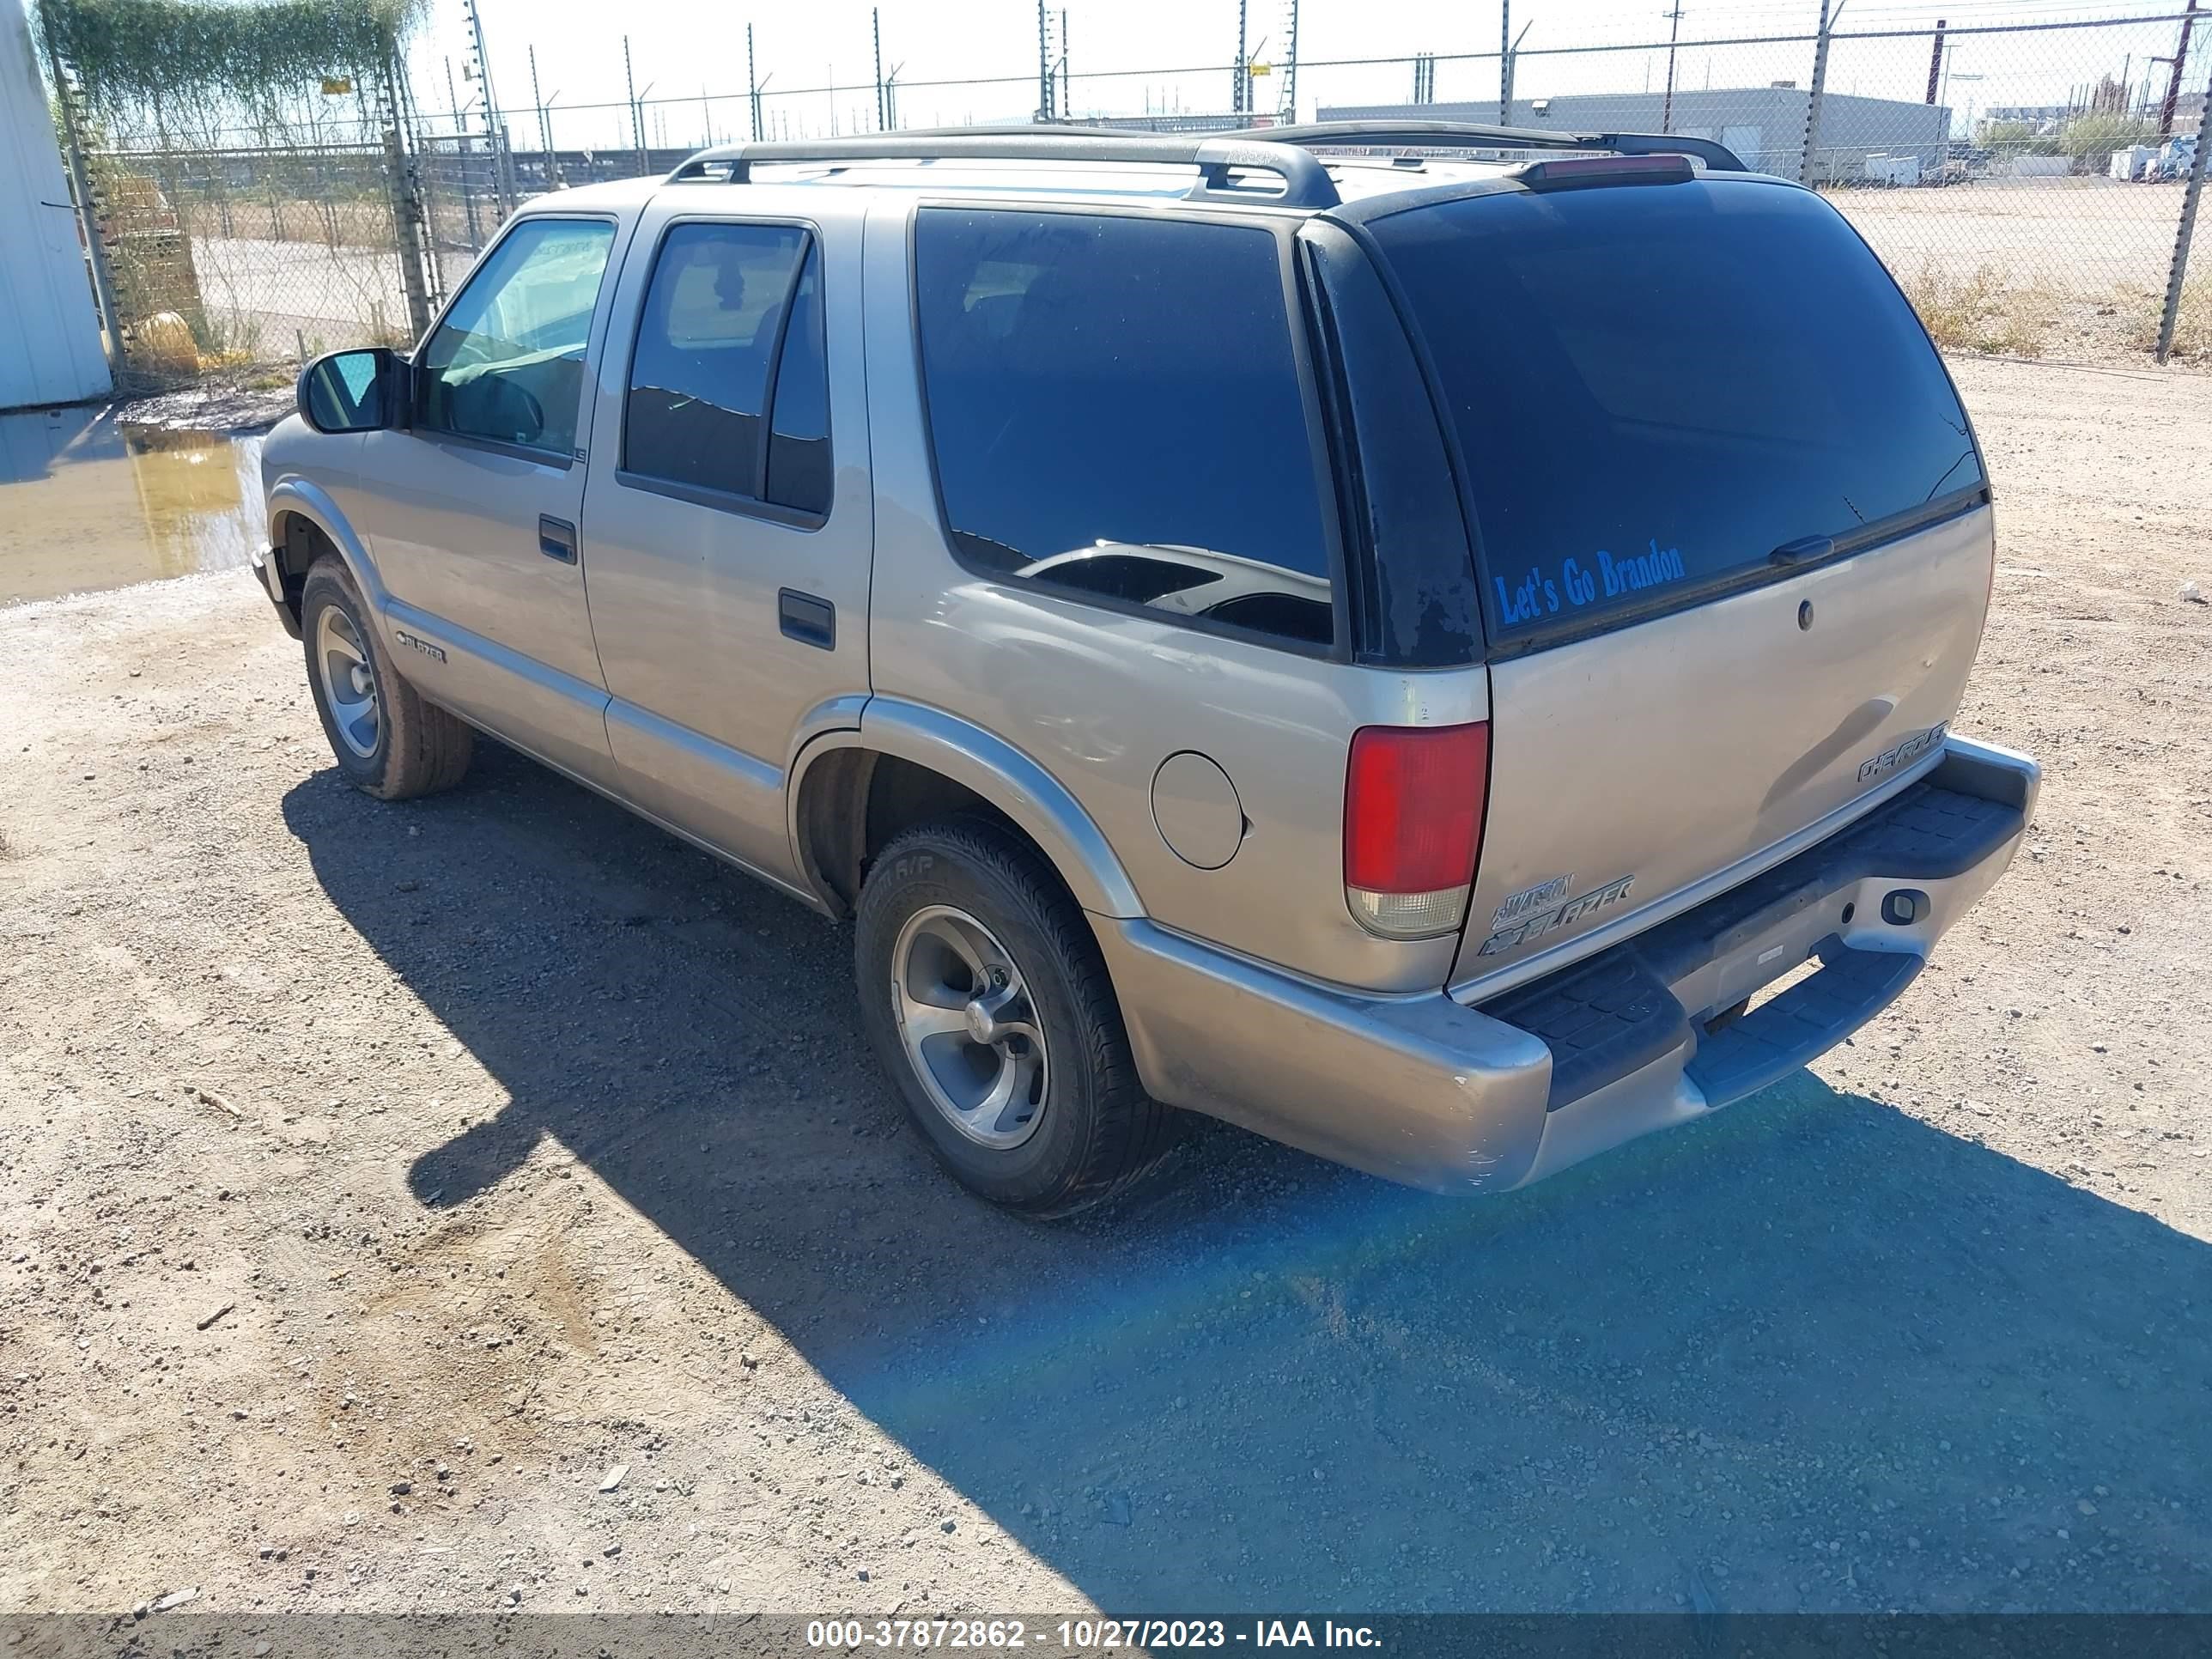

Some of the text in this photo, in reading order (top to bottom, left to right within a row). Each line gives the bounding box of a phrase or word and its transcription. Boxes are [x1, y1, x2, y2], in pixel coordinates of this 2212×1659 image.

[1495, 538, 1686, 624] Let's Go Brandon
[405, 635, 447, 664] BLAZER
[1857, 720, 1950, 782] CHEVROLET
[1523, 877, 1635, 941] BLAZER
